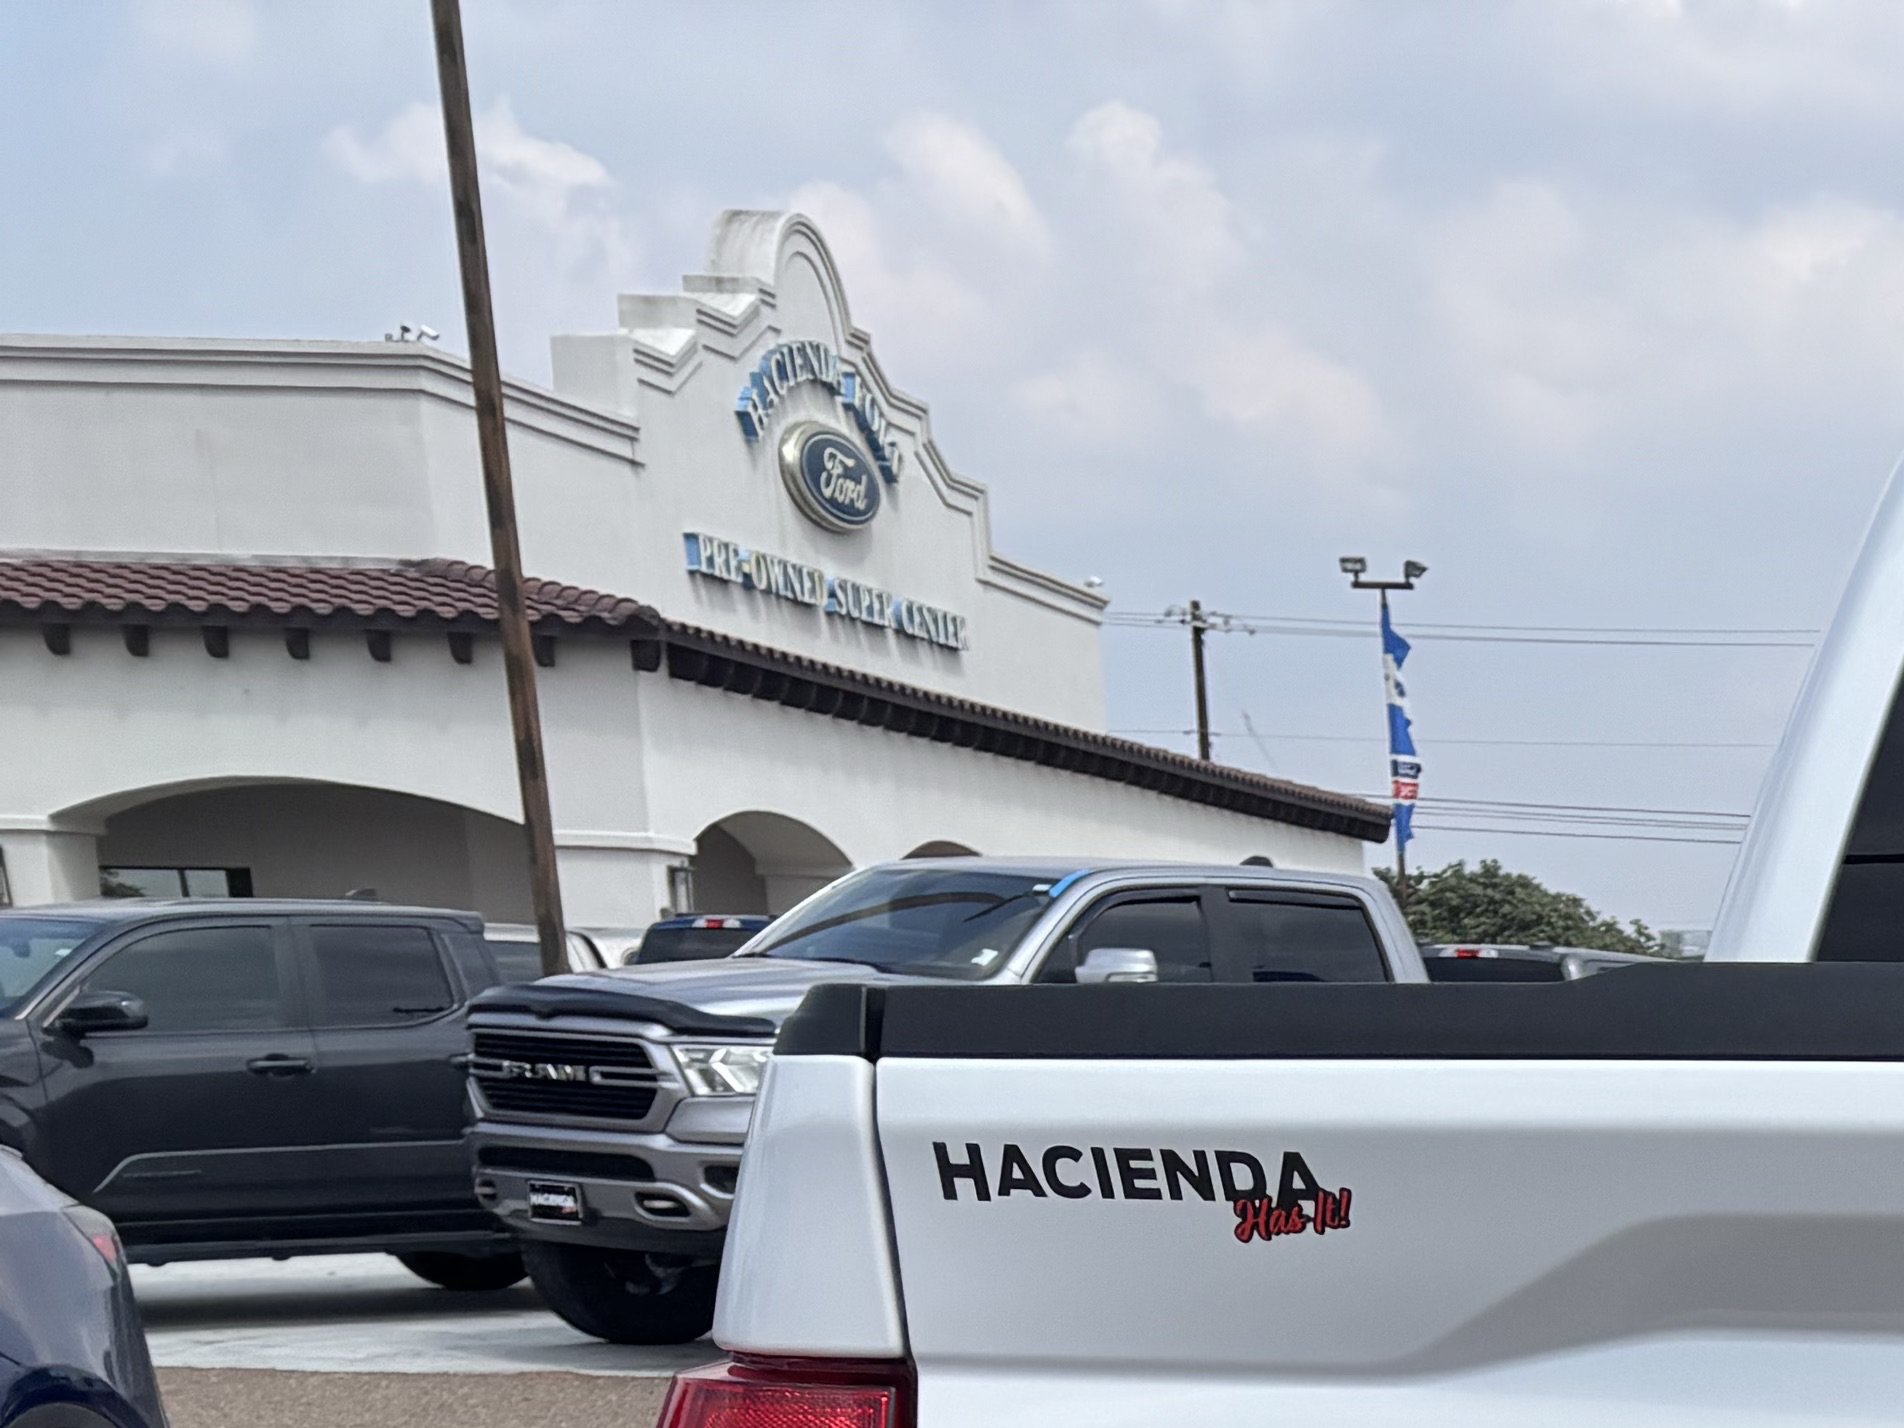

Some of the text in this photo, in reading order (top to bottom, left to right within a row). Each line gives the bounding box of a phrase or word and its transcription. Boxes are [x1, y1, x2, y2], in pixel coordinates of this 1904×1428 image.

[820, 447, 868, 511] Ford
[690, 533, 828, 608] PRE-OWNED
[832, 577, 897, 628] SUPER
[502, 1061, 587, 1081] RAM
[932, 1141, 1325, 1206] HACIENDA
[1233, 1187, 1352, 1243] Has It!
